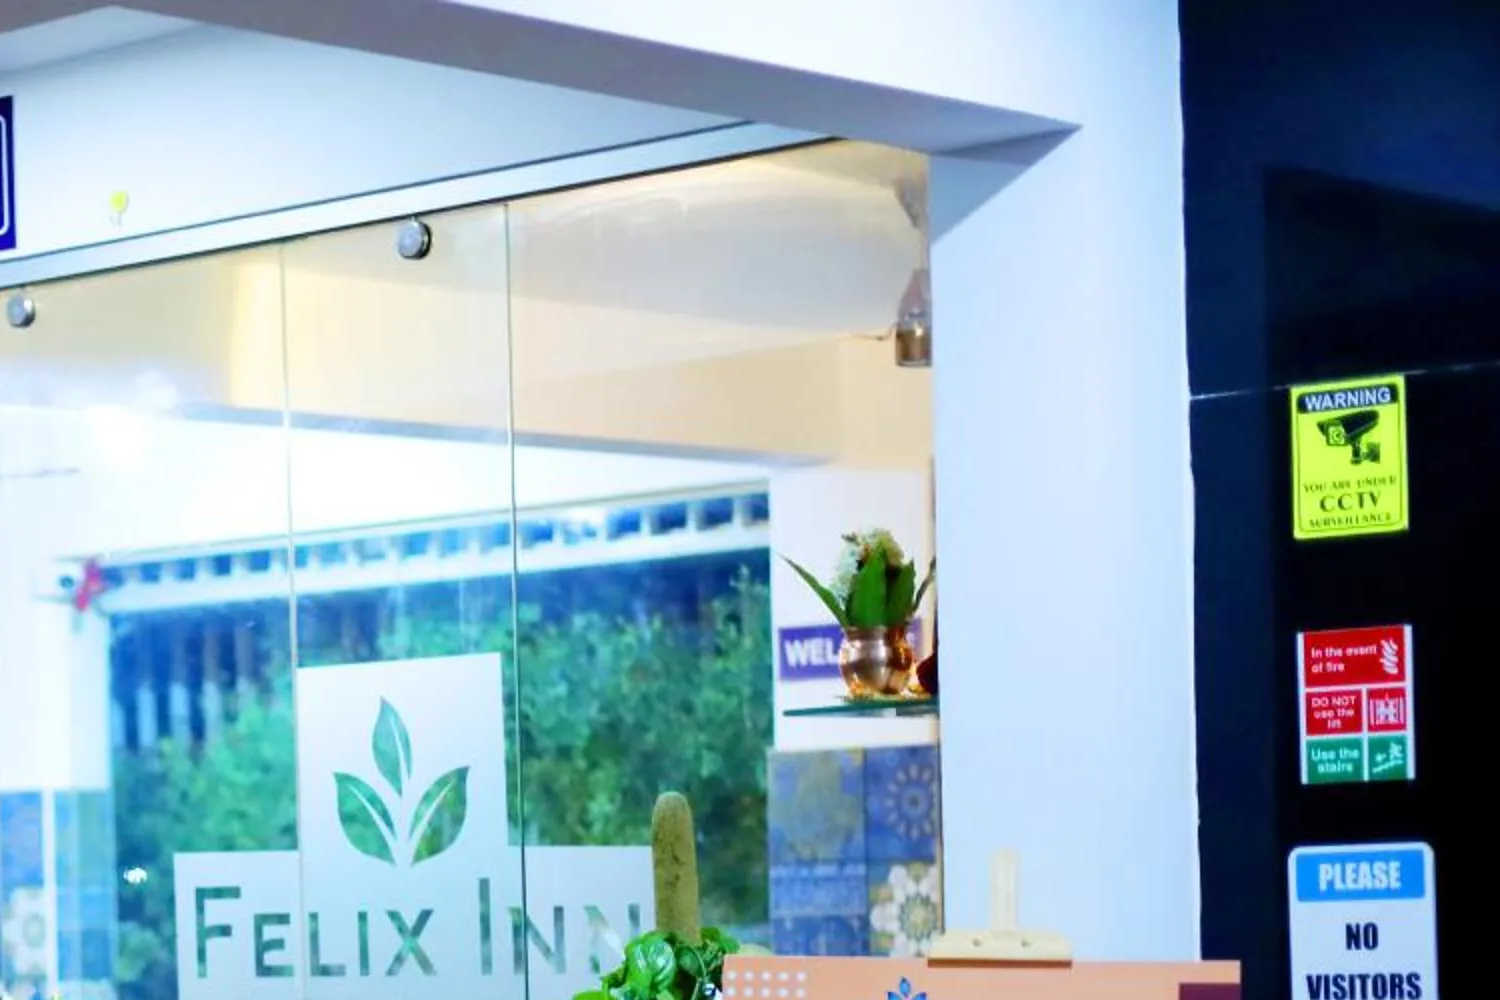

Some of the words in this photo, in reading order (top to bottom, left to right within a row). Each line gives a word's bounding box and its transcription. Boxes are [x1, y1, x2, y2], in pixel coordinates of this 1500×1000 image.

[1305, 387, 1391, 412] WARNING
[1303, 483, 1327, 493] YOU
[1320, 491, 1382, 513] CCTV
[1325, 647, 1343, 657] the
[1345, 644, 1377, 656] event
[1326, 661, 1345, 673] fire
[1311, 696, 1329, 708] DO
[1332, 695, 1357, 706] NOT
[1314, 709, 1335, 719] use
[1337, 708, 1355, 718] the
[1311, 747, 1336, 762] Use
[1339, 747, 1360, 760] the
[1317, 760, 1354, 774] stairs
[1318, 861, 1402, 892] PLEASE
[195, 886, 437, 979] FELIX
[1345, 922, 1379, 951] NO
[1306, 972, 1422, 1000] VISITORS
